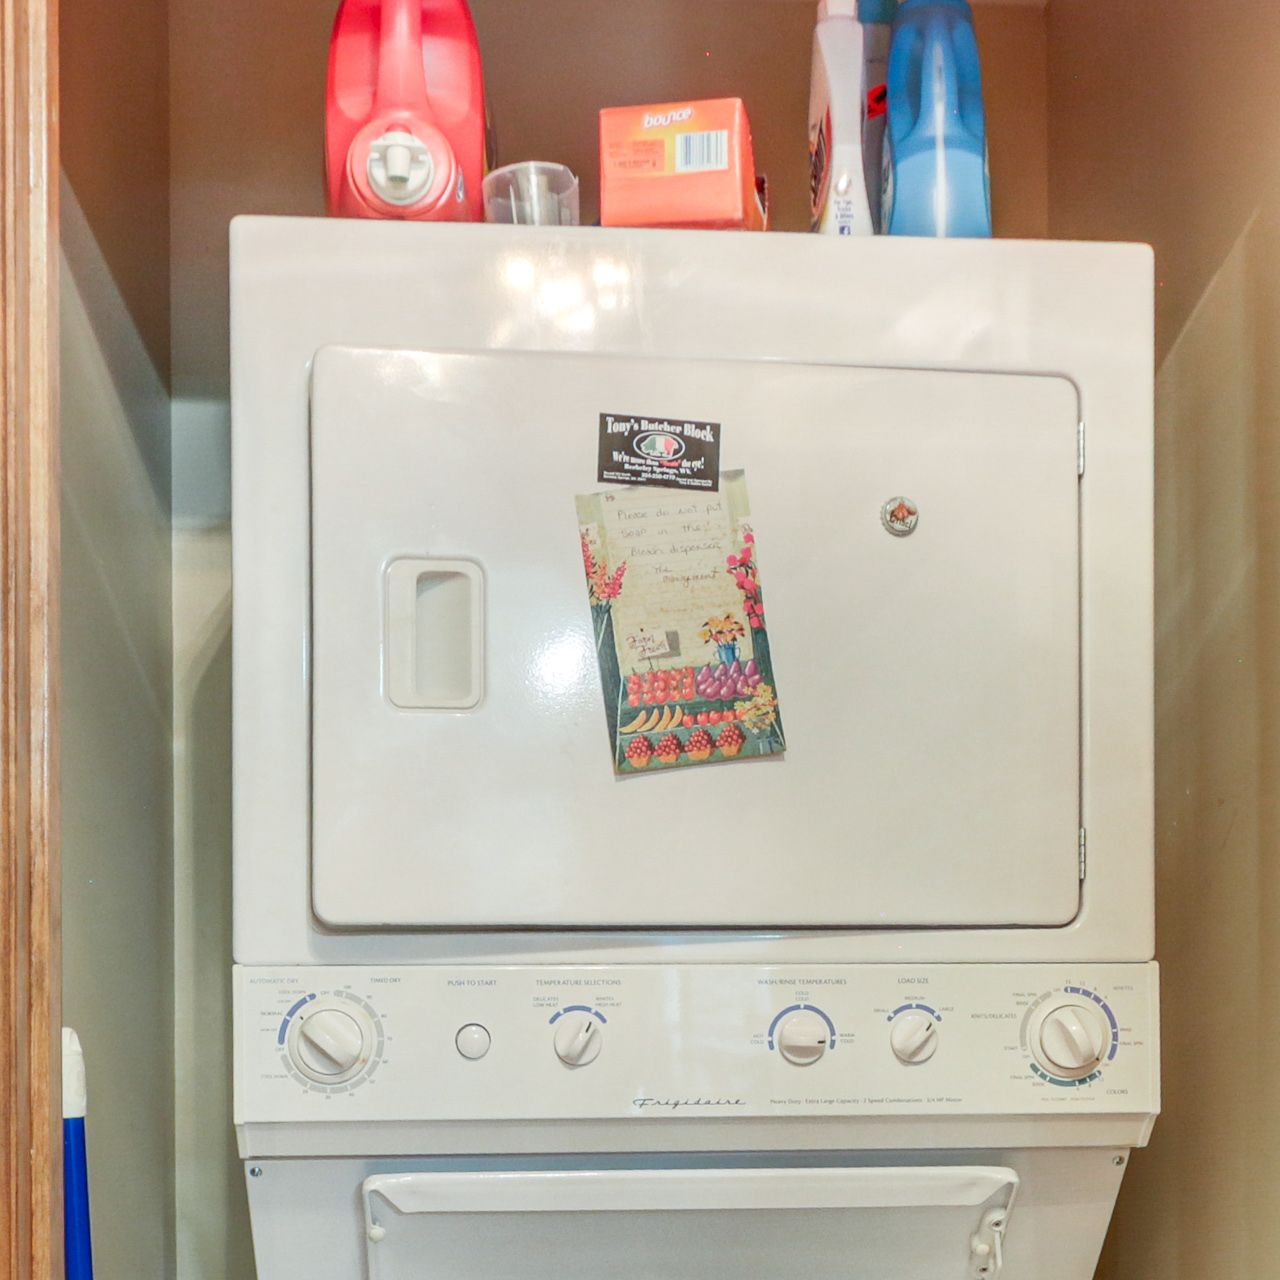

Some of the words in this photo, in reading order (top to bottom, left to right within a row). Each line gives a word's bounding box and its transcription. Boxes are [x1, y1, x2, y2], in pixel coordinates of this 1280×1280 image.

[606, 416, 639, 437] Tony's
[640, 419, 683, 434] Butcher
[683, 423, 715, 442] Block
[447, 979, 466, 987] PUSH
[467, 979, 477, 987] TO
[477, 979, 498, 987] START
[535, 979, 583, 987] TEMPERATURE
[583, 979, 622, 987] SELECTIONS
[798, 978, 847, 986] TEMPERATURES
[897, 977, 916, 985] LOAD
[916, 977, 930, 985] SIZE
[632, 1097, 748, 1110] Frigidaire
